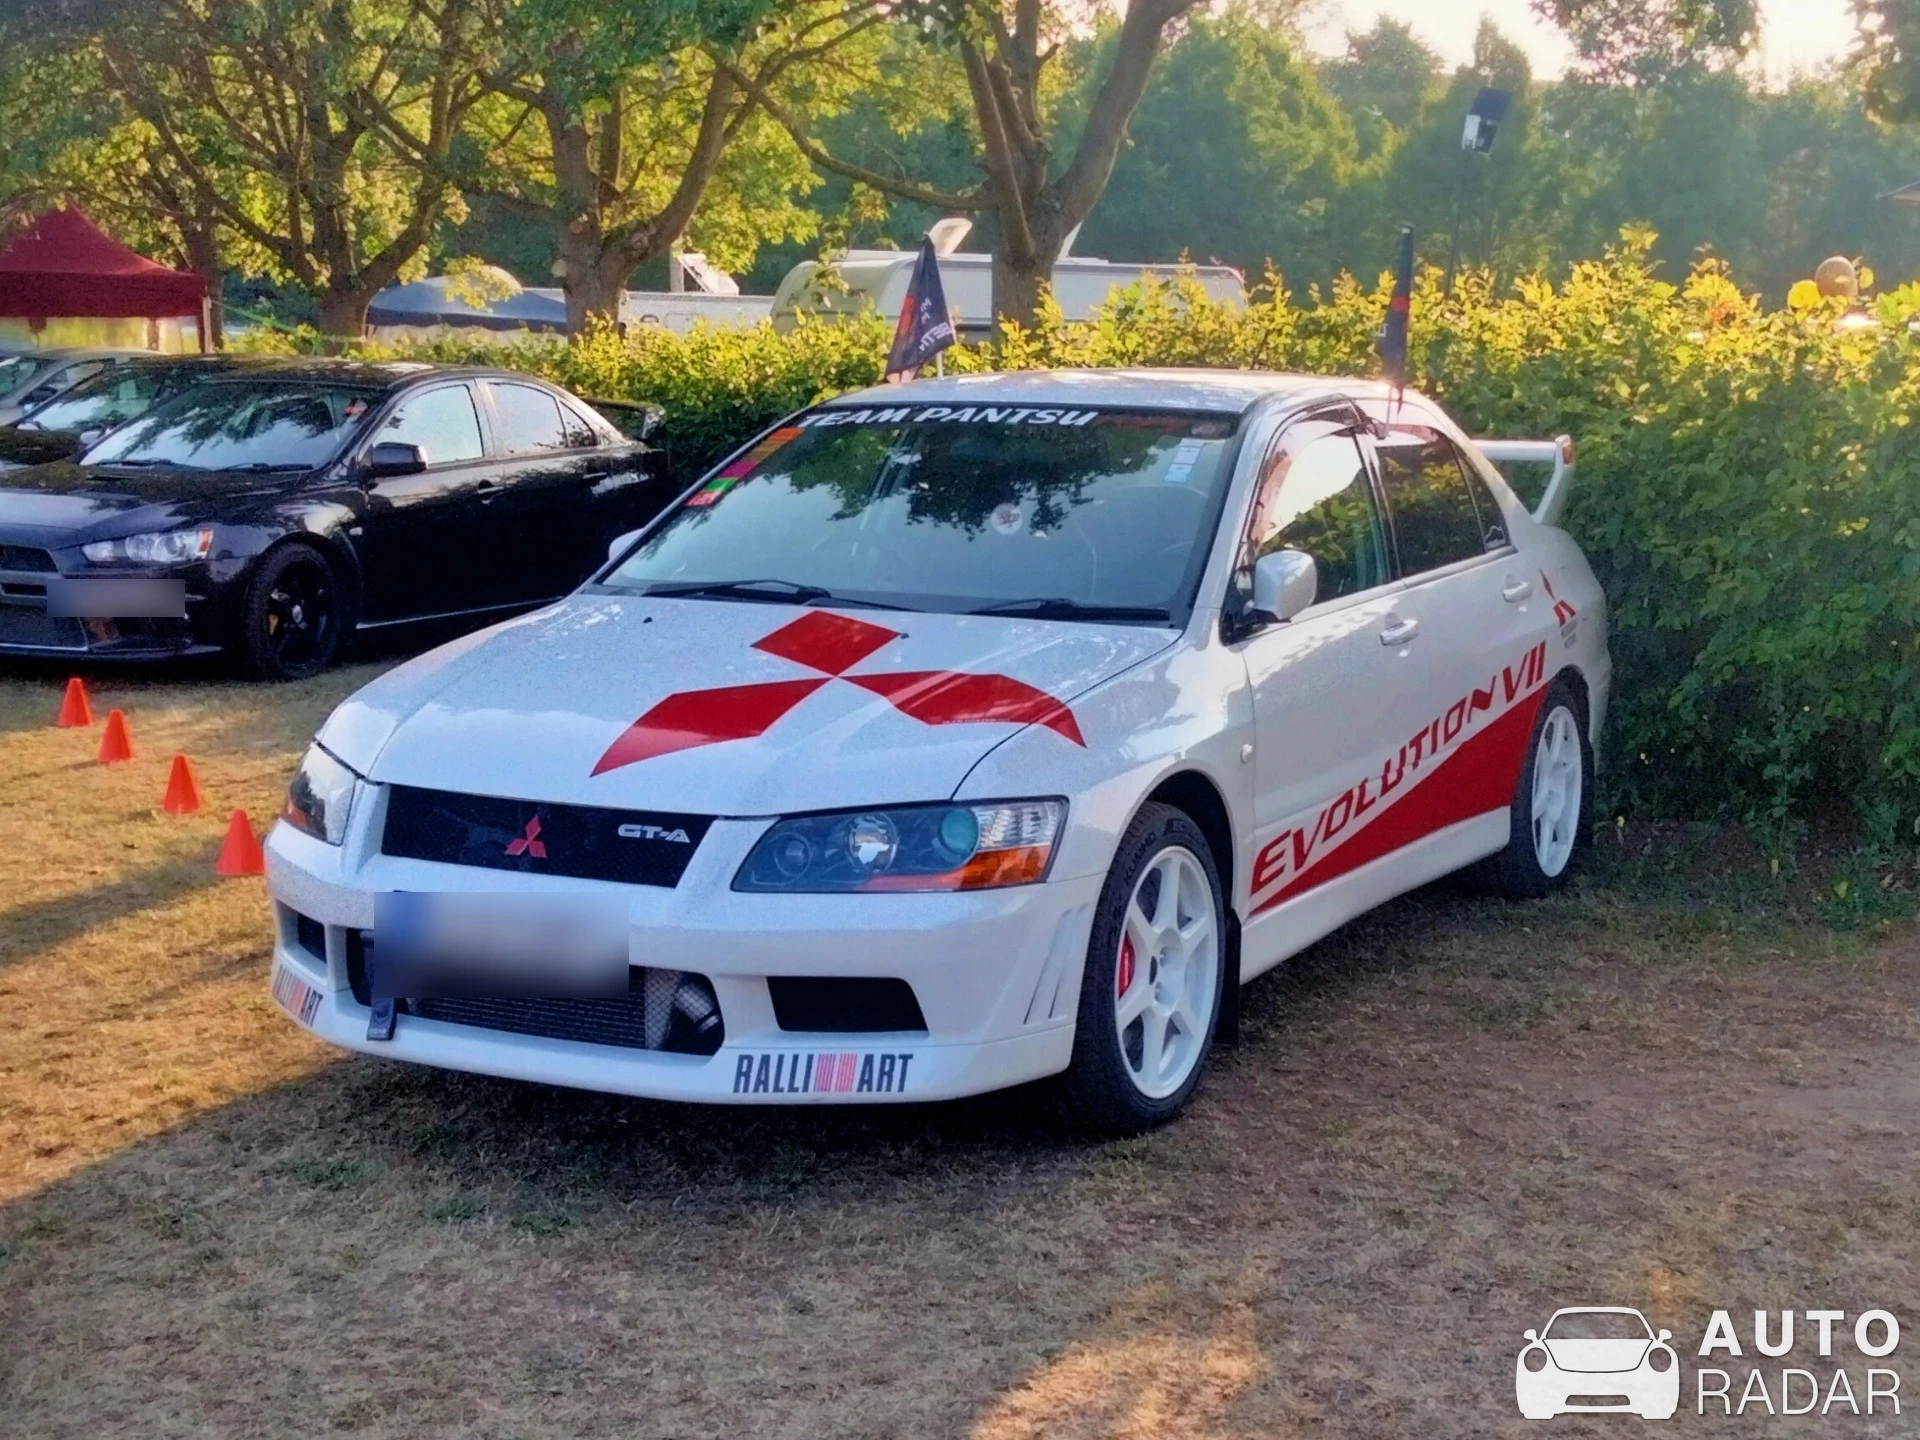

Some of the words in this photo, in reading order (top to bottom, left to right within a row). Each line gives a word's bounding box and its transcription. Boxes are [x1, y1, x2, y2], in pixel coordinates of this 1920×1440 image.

[797, 408, 911, 428] TEAM
[913, 407, 1099, 426] PANTSU
[1250, 674, 1497, 896] EVOLUTION
[1502, 640, 1547, 703] VII
[617, 823, 691, 843] GT-A
